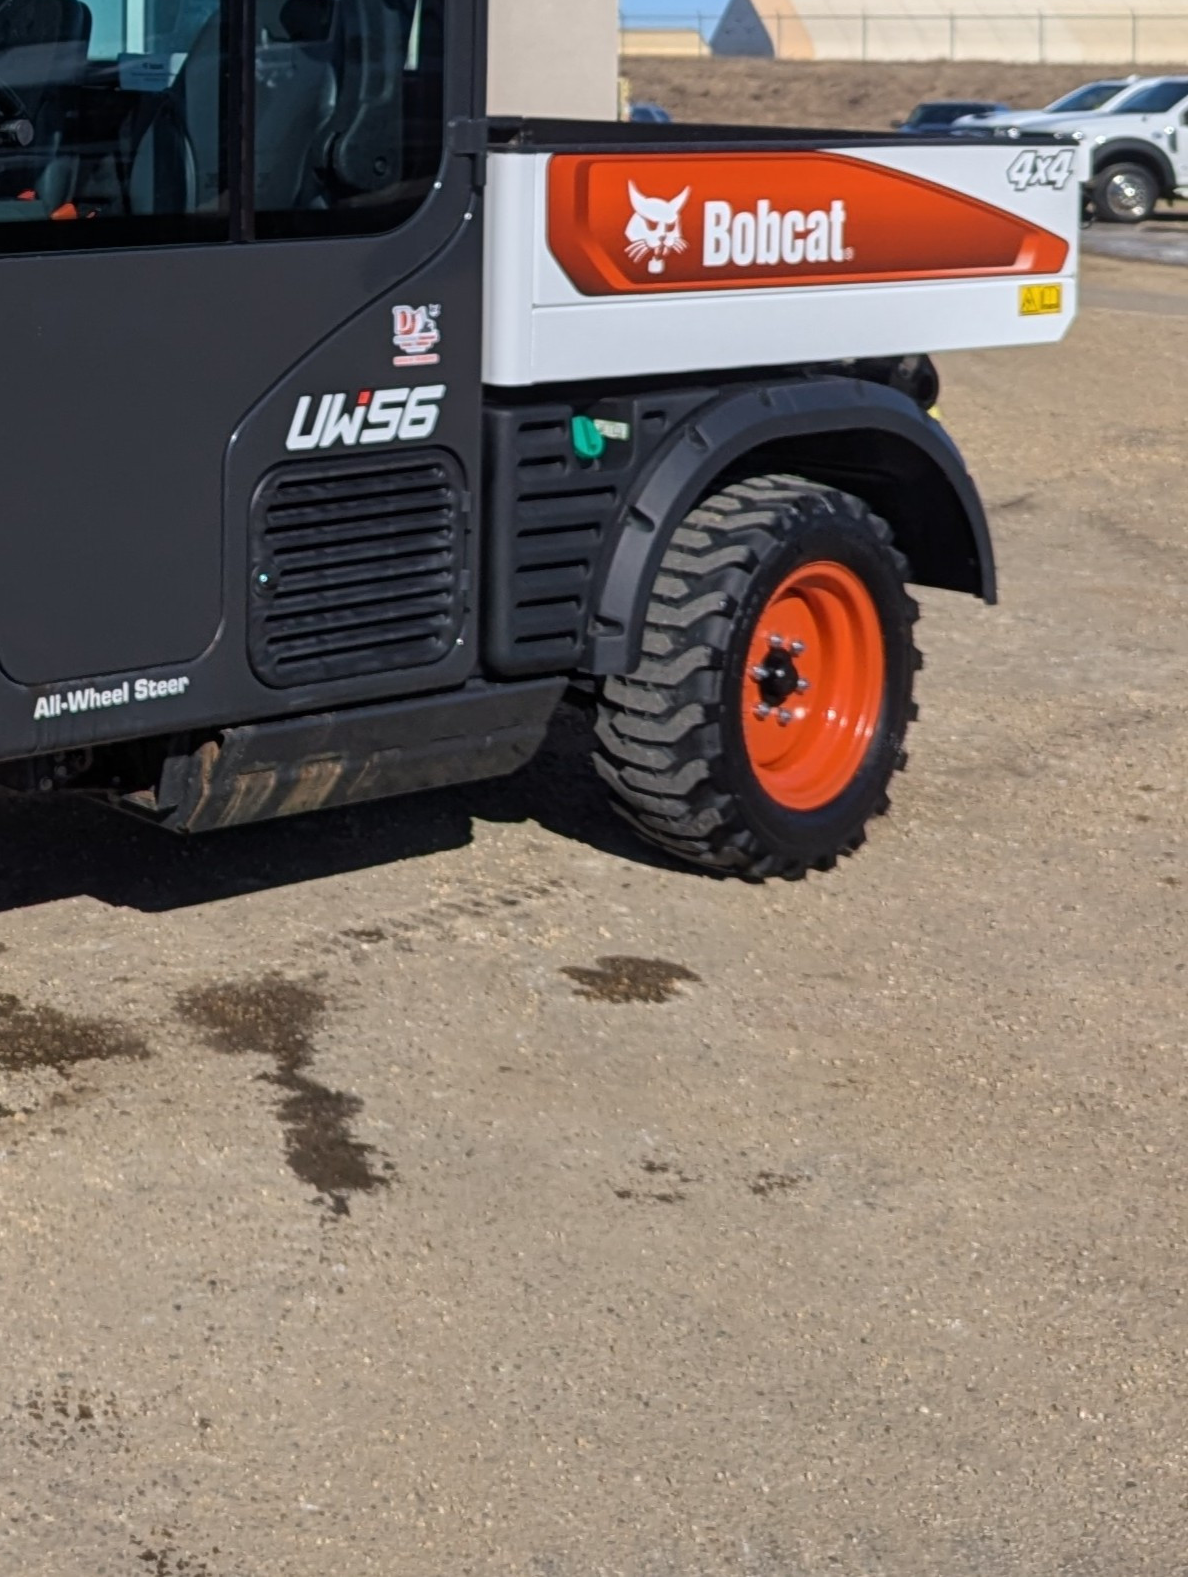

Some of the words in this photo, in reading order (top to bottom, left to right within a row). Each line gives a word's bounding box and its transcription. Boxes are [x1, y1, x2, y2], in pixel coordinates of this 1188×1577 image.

[1007, 149, 1076, 191] 4x4
[703, 199, 846, 267] Bobcat
[33, 681, 129, 719] All-Wheel
[134, 676, 190, 701] Steer
